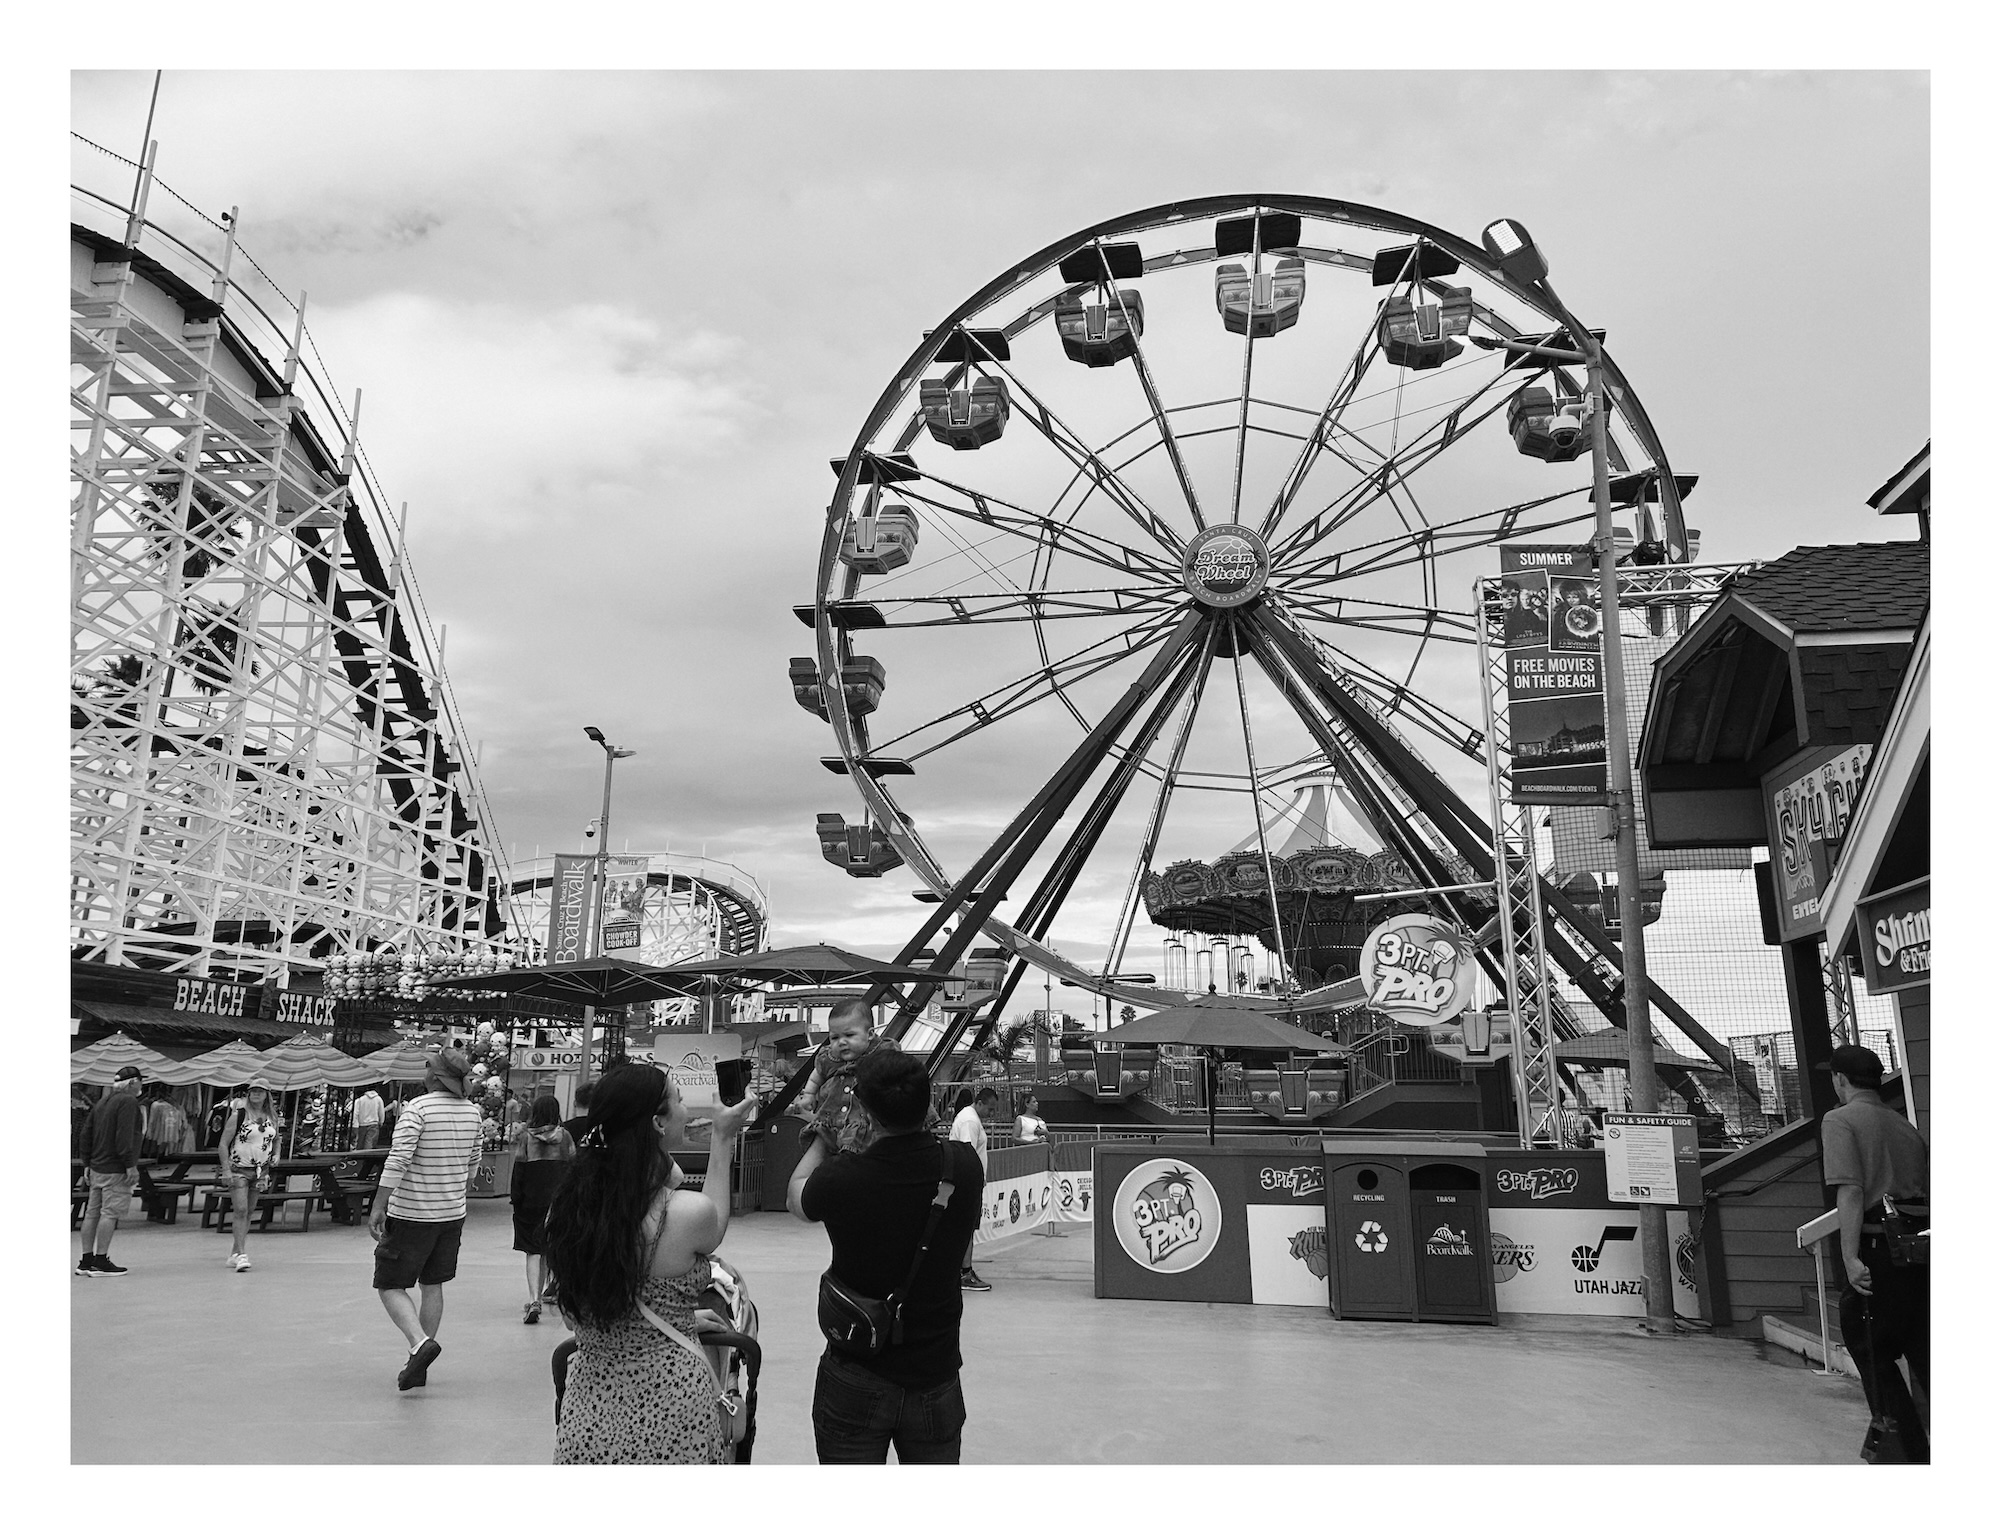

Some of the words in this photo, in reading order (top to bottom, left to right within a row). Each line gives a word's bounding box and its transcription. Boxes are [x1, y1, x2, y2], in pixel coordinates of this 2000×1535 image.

[1232, 528, 1254, 541] CRUZ
[1196, 548, 1255, 565] Dream
[1519, 552, 1573, 566] SUMMER
[1197, 565, 1251, 581] Wheel
[1189, 575, 1211, 598] BEACH
[1215, 573, 1263, 602] BOARDWALK
[1513, 659, 1545, 673] FREE
[1548, 657, 1596, 672] MOVIES
[1513, 675, 1531, 689] ON
[1531, 674, 1556, 688] THE
[1557, 673, 1596, 688] BEACH
[559, 881, 568, 903] Beach
[555, 860, 587, 964] Boardwalk
[556, 910, 565, 930] Cruz
[555, 929, 563, 950] Santa
[606, 931, 638, 940] CHOWDER
[606, 939, 638, 949] COOK-OFF
[173, 978, 247, 1016] BEACH
[1369, 965, 1456, 1012] PRO
[276, 992, 337, 1027] SHACK
[671, 1072, 718, 1086] Boardwal
[1608, 1116, 1626, 1124] FUN
[1627, 1116, 1634, 1124] &
[1636, 1117, 1666, 1125] SAFETY
[1666, 1118, 1692, 1126] GUIDE
[1290, 1166, 1324, 1197] PR
[1528, 1168, 1579, 1200] PRO
[1352, 1194, 1385, 1202] RECYCLING
[1435, 1195, 1457, 1203] TRASH
[1140, 1208, 1201, 1264] PRO
[1289, 1230, 1327, 1260] KNIC
[1426, 1244, 1475, 1256] Boardwalk
[1491, 1250, 1539, 1272] KERS
[1574, 1279, 1609, 1294] UTAH
[1611, 1280, 1643, 1295] JAZZ
